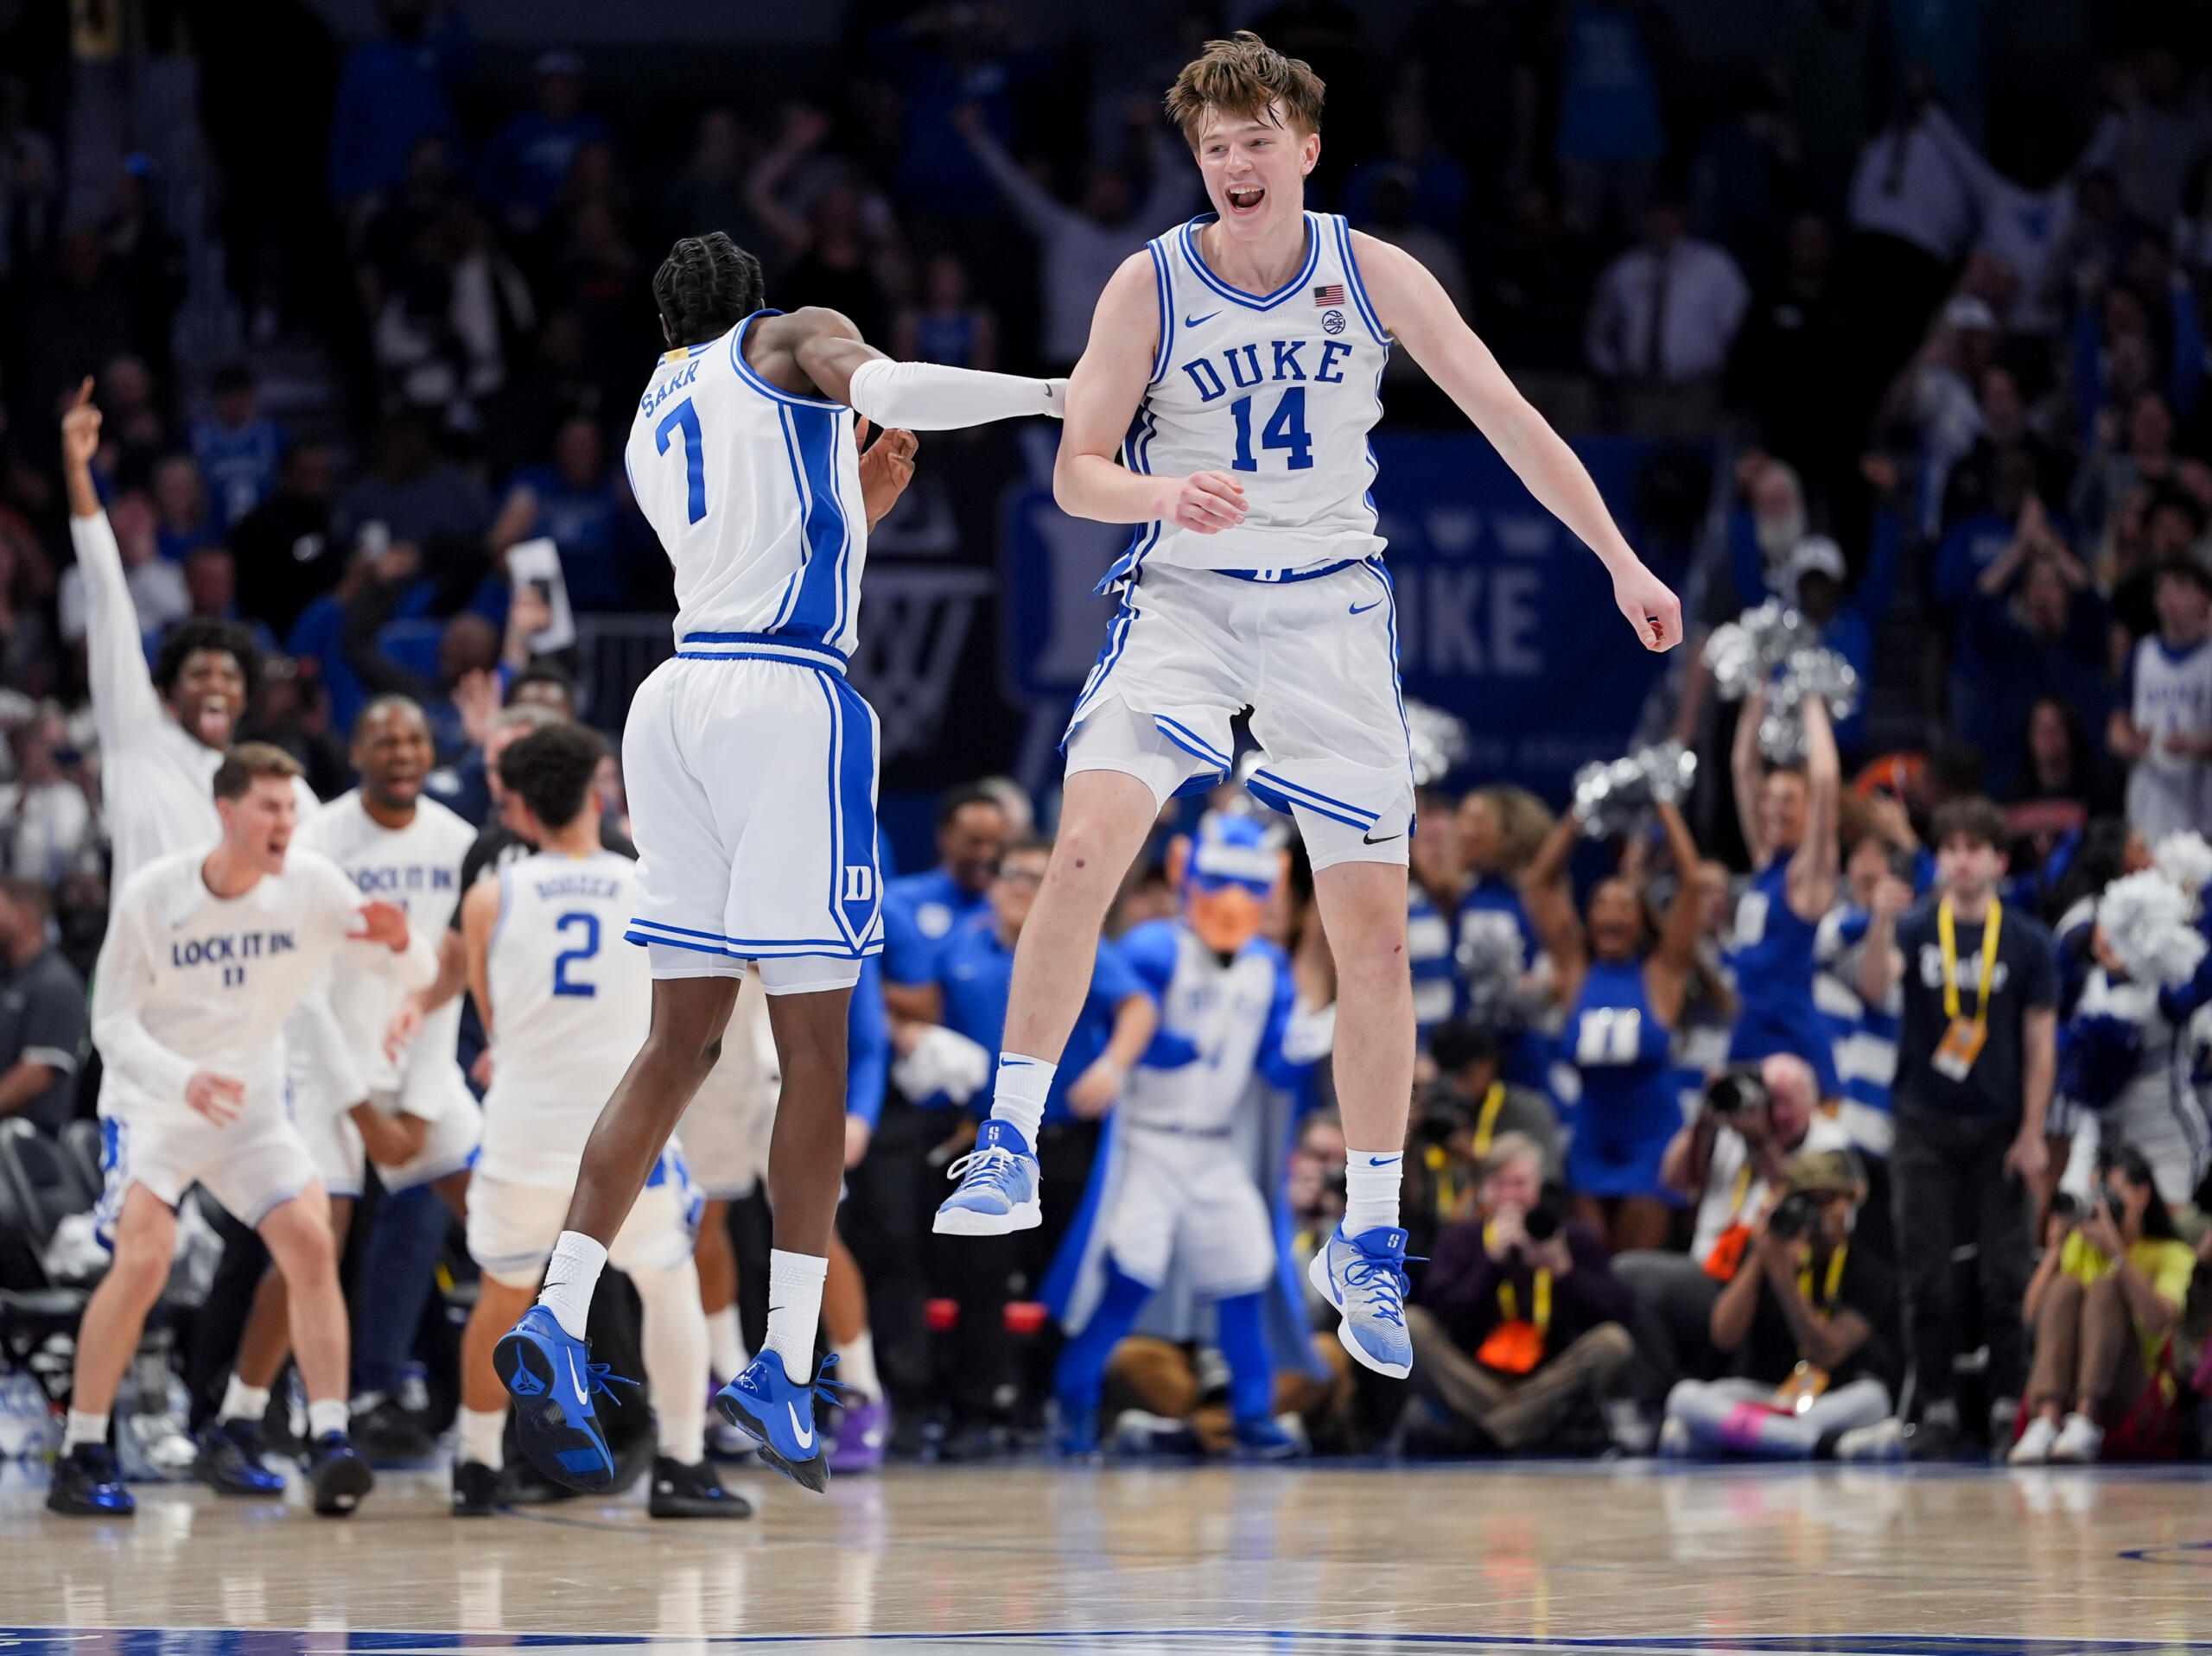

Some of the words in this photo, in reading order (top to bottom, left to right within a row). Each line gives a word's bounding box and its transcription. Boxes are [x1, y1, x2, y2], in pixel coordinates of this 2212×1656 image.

[641, 358, 701, 418] SARR
[1181, 340, 1353, 403] DUKE
[655, 396, 707, 525] 7
[1231, 386, 1313, 472] 14
[843, 866, 872, 900] D
[172, 936, 233, 968] LOCK
[243, 933, 262, 957] IT
[553, 912, 600, 997] 2
